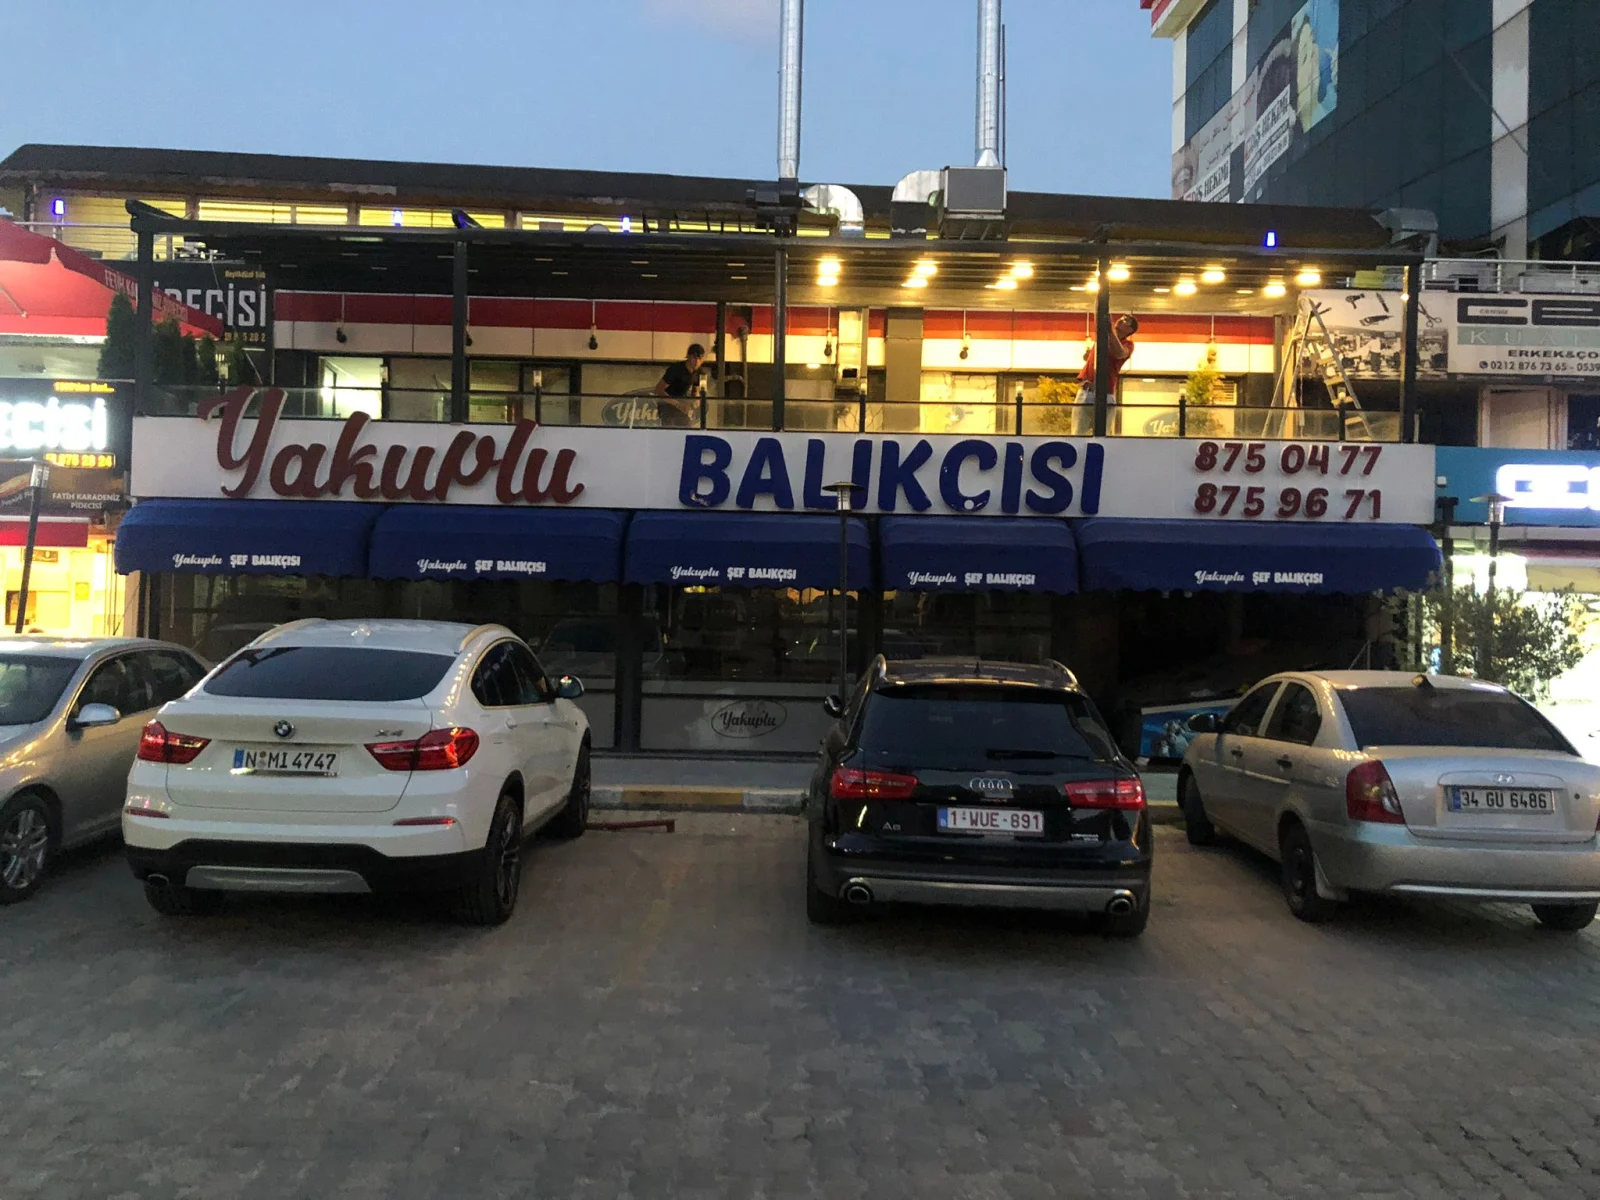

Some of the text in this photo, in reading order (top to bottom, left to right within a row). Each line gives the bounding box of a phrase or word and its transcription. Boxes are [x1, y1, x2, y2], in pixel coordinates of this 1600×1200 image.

[1490, 361, 1515, 370] 0212
[1518, 362, 1537, 371] 876
[1540, 363, 1552, 371] 73
[1555, 362, 1567, 371] 65
[197, 384, 585, 503] Yakuplu
[1195, 441, 1382, 476] 875 04 77
[52, 492, 120, 502] FATİH KARADENİZ
[1194, 482, 1382, 519] 875 96 71
[172, 554, 301, 569] Yakuplu ŞEF BALIKÇISI
[417, 559, 546, 575] Yakuplu ŞEF BALIKÇISI
[670, 566, 797, 582] Yakuplu ŞEF BALIKÇISI
[907, 571, 1035, 588] Yakuplu ŞEF BALIKÇISI
[1194, 570, 1324, 586] Yakuplu ŞEF BALIKÇISI
[720, 710, 776, 730] Yakuplu
[245, 751, 256, 768] N
[292, 752, 337, 770] 4747
[1462, 791, 1547, 809] 34 GU 6486
